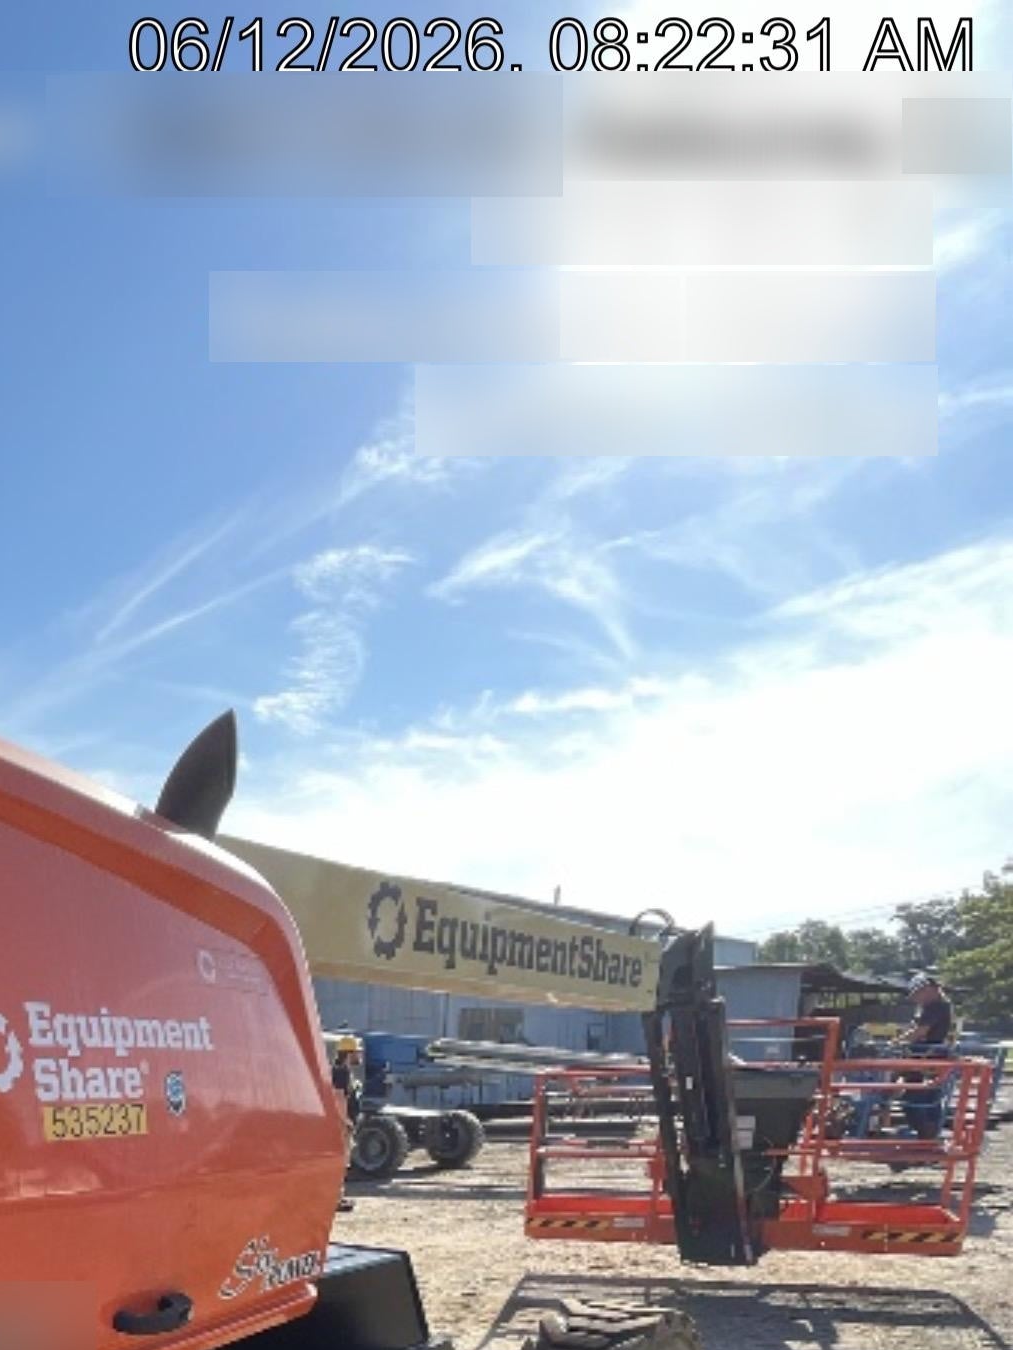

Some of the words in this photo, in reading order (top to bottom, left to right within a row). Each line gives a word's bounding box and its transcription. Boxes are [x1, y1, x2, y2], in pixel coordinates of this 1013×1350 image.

[413, 896, 643, 988] EquipmentShare
[24, 1001, 215, 1057] Equipment
[51, 1103, 144, 1138] 535237
